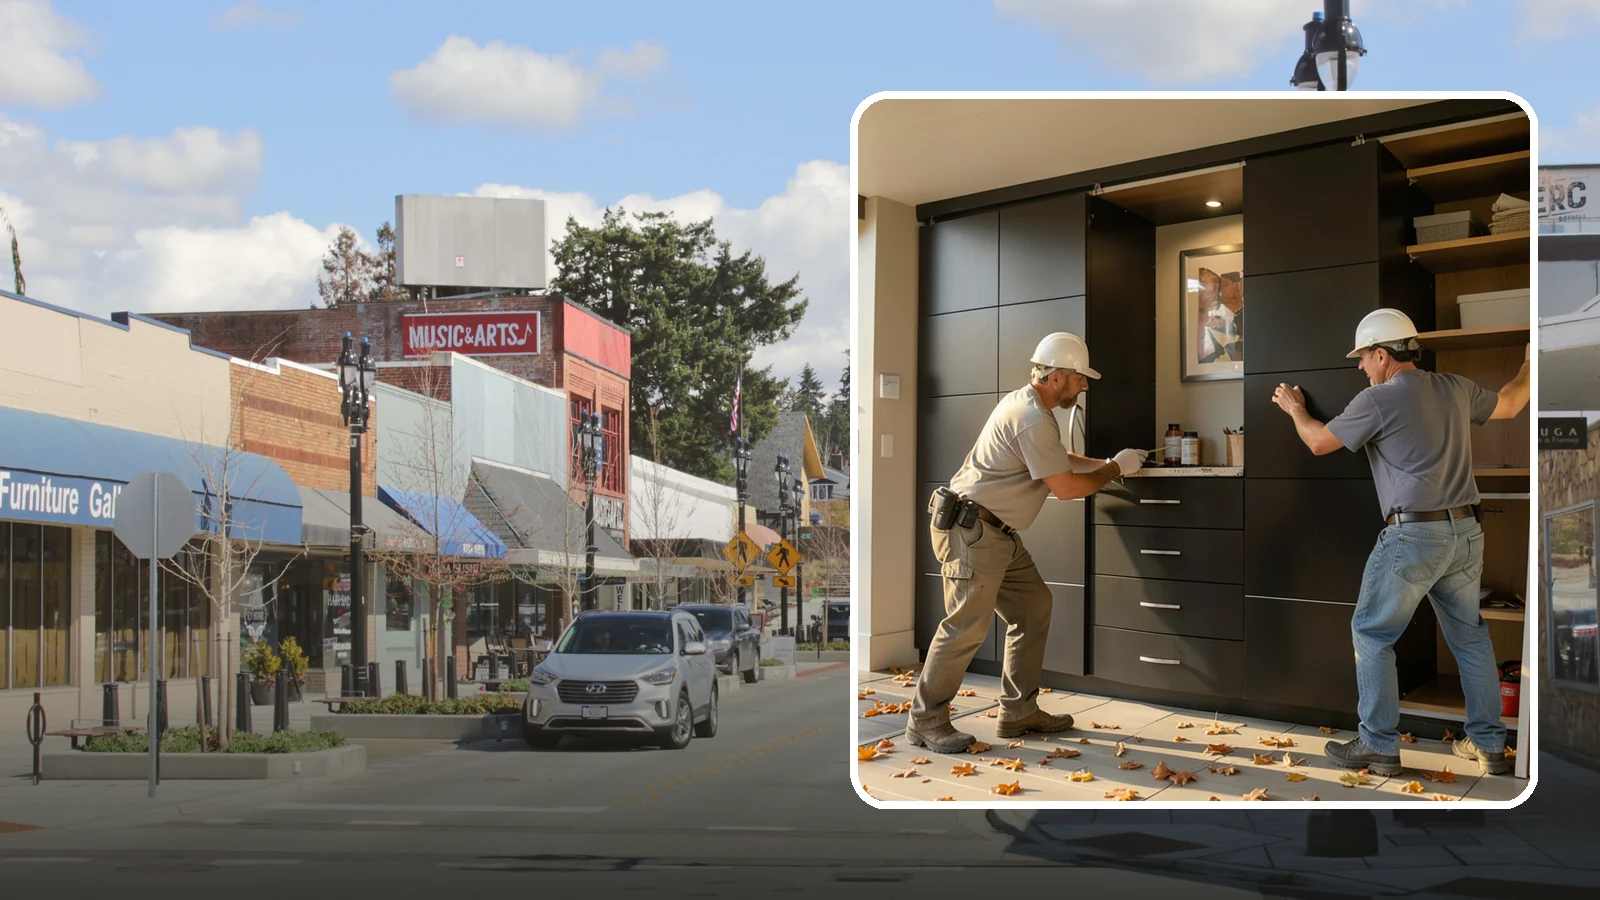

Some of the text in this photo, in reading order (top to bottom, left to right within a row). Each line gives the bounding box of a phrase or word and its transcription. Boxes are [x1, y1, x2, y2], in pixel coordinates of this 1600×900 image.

[409, 323, 520, 349] MUSIC&ARTS
[0, 471, 122, 519] Furniture Gal
